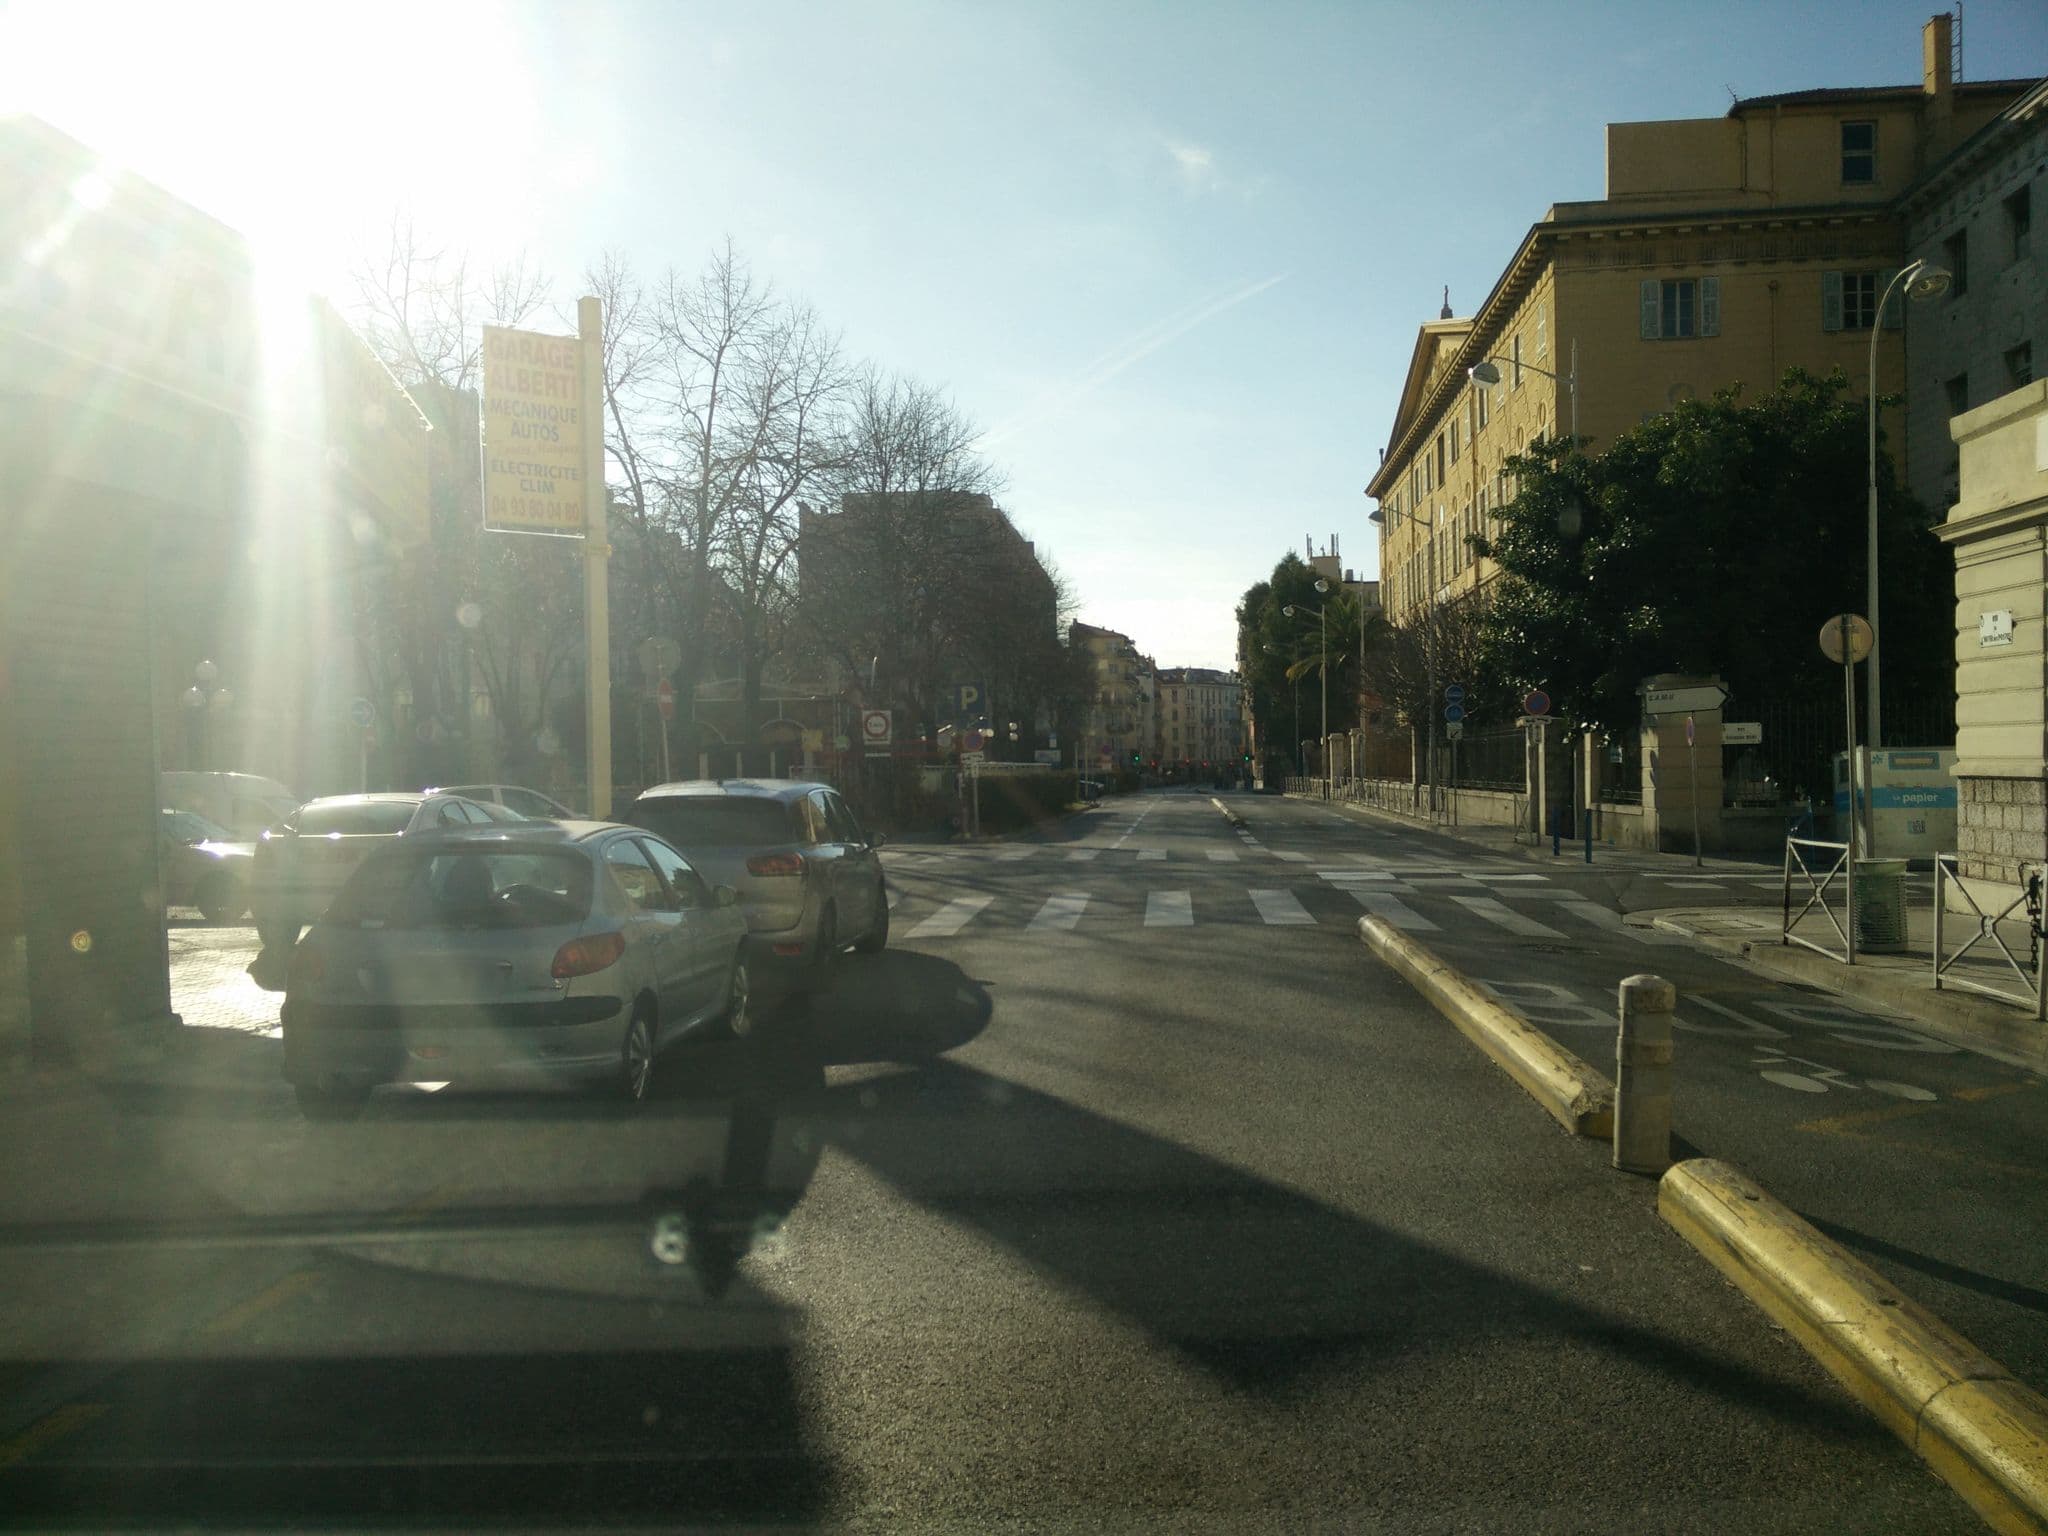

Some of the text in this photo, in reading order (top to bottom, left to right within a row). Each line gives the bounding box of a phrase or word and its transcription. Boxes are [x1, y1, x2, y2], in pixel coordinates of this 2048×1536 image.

[489, 334, 575, 370] GARAGE
[491, 363, 577, 400] ALBERTI
[490, 398, 577, 424] MECANIQUE
[511, 422, 559, 442] AUTOS
[490, 460, 579, 480] ELECTRICITE
[519, 479, 555, 494] CLIM
[1902, 793, 1939, 804] papier
